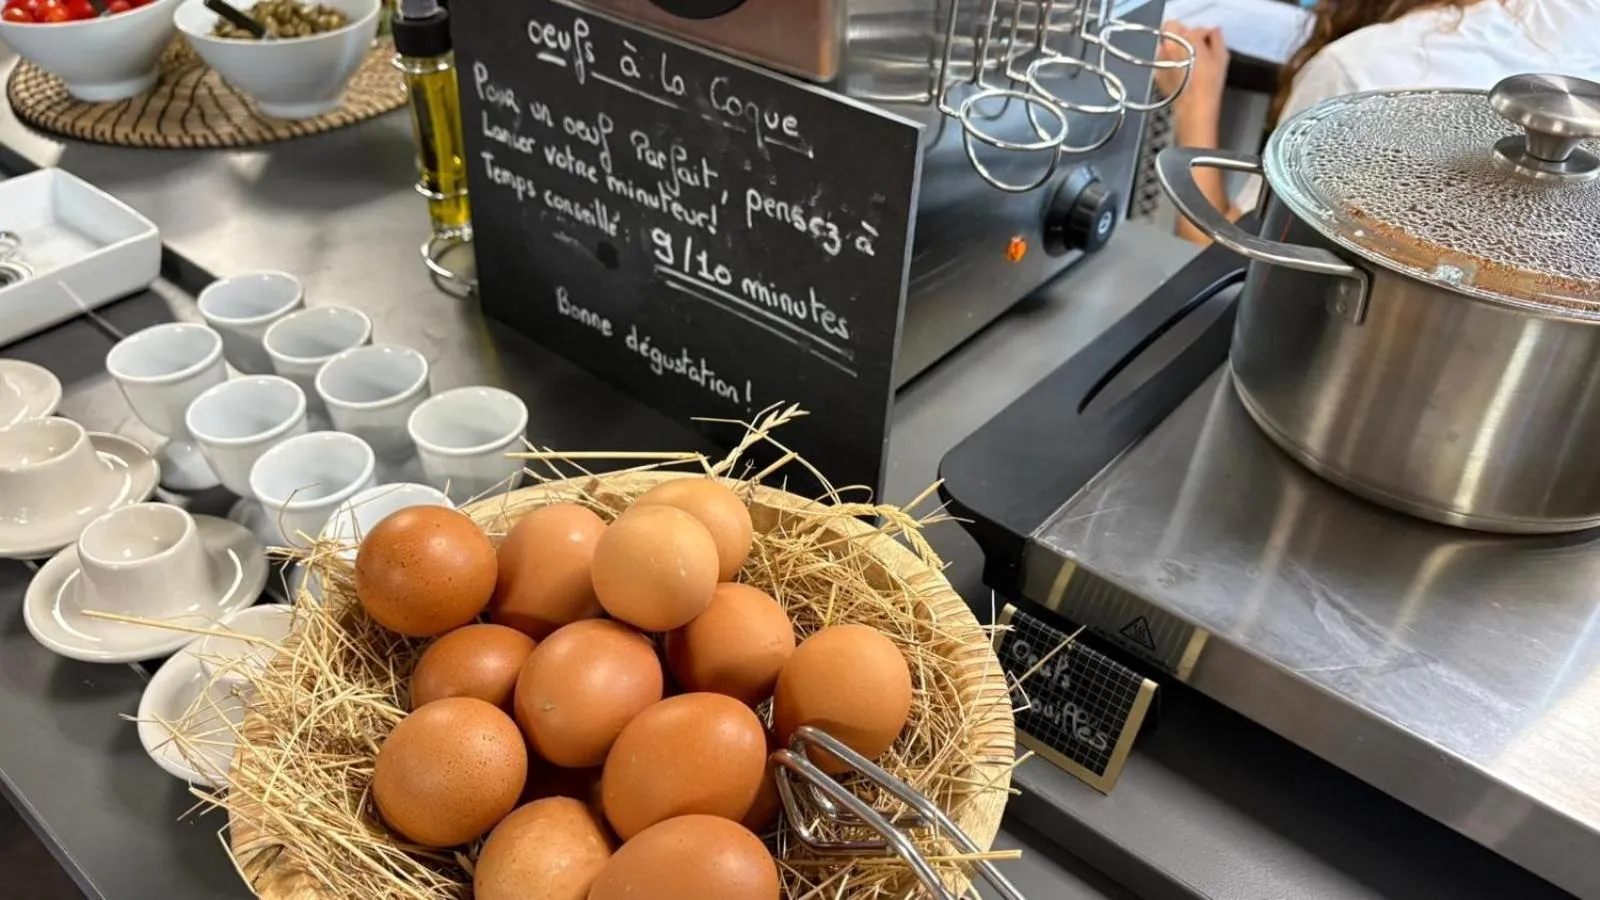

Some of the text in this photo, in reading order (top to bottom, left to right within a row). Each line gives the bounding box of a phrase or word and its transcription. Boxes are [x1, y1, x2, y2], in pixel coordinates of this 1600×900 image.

[619, 39, 641, 79] à
[710, 76, 800, 149] Coque
[529, 101, 555, 128] un
[854, 219, 880, 257] à
[543, 143, 599, 184] votre
[480, 150, 538, 203] Temps
[651, 227, 733, 286] 9/10
[741, 278, 850, 340] minutes
[555, 286, 615, 337] Bonne
